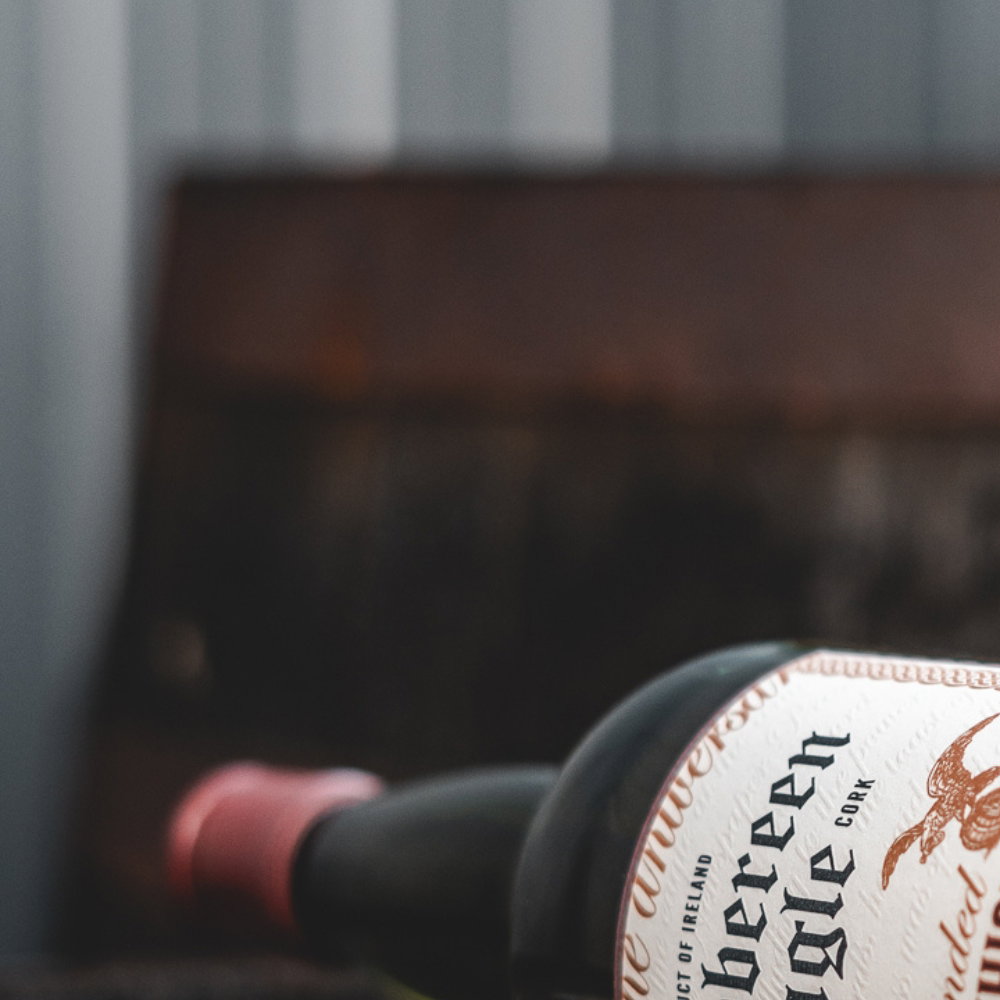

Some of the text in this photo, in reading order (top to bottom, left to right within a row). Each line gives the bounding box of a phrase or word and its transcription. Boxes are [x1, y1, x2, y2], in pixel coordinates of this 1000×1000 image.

[835, 778, 876, 828] CORK
[681, 854, 713, 933] IRELAND
[678, 940, 694, 964] OF
